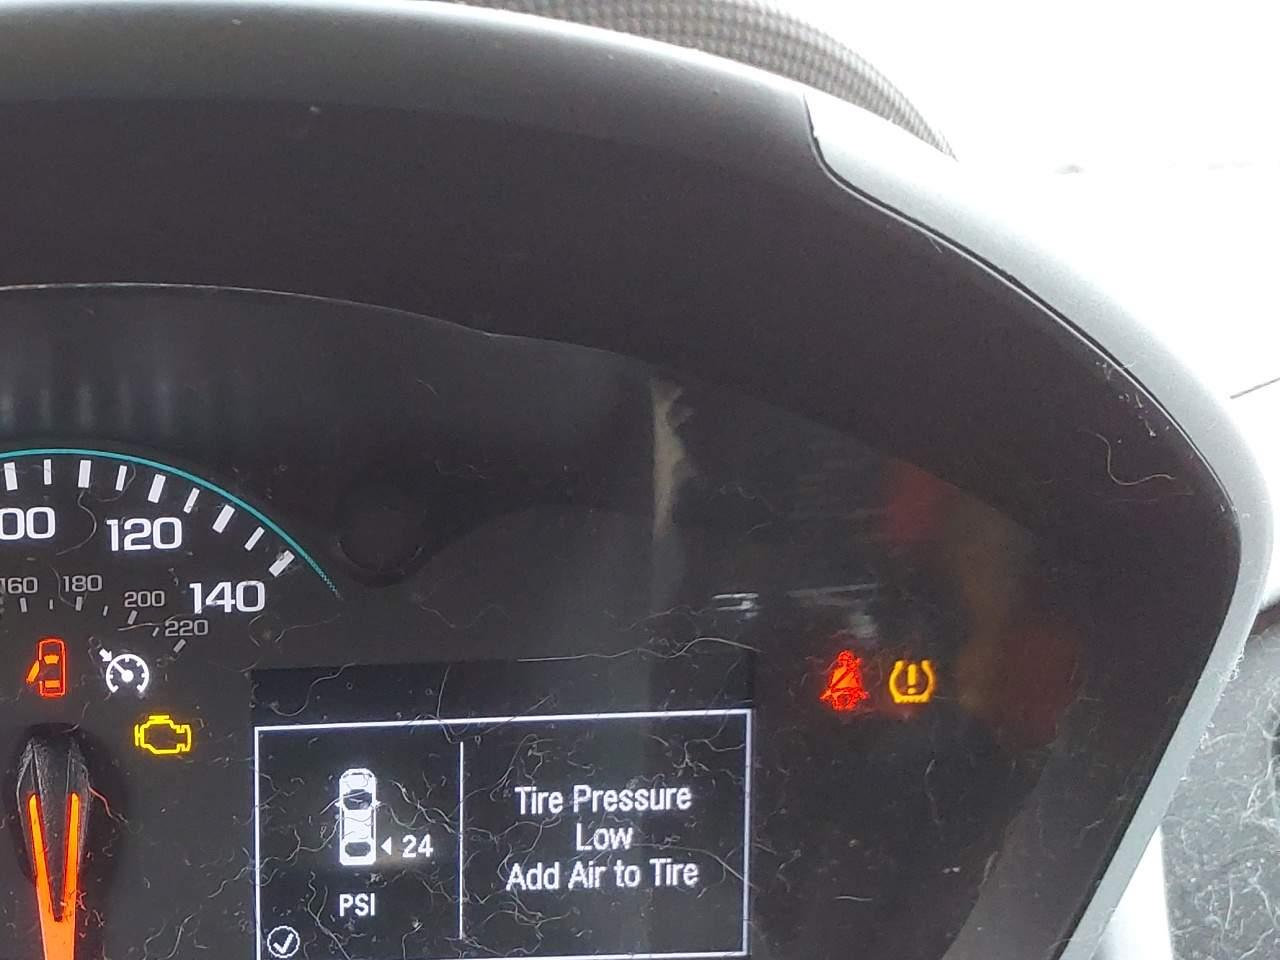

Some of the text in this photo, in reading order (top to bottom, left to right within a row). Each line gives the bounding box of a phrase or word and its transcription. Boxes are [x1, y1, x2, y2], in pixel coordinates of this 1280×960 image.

[105, 517, 183, 552] 120
[0, 576, 38, 595] 160
[63, 574, 103, 593] 180
[124, 590, 165, 608] 200
[189, 581, 267, 615] 140
[165, 618, 209, 637] 220
[514, 784, 692, 815] Tire Pressure
[402, 835, 433, 858] 24
[576, 822, 633, 851] Low
[506, 858, 699, 891] Add Air to Tire
[339, 893, 376, 917] PSI
